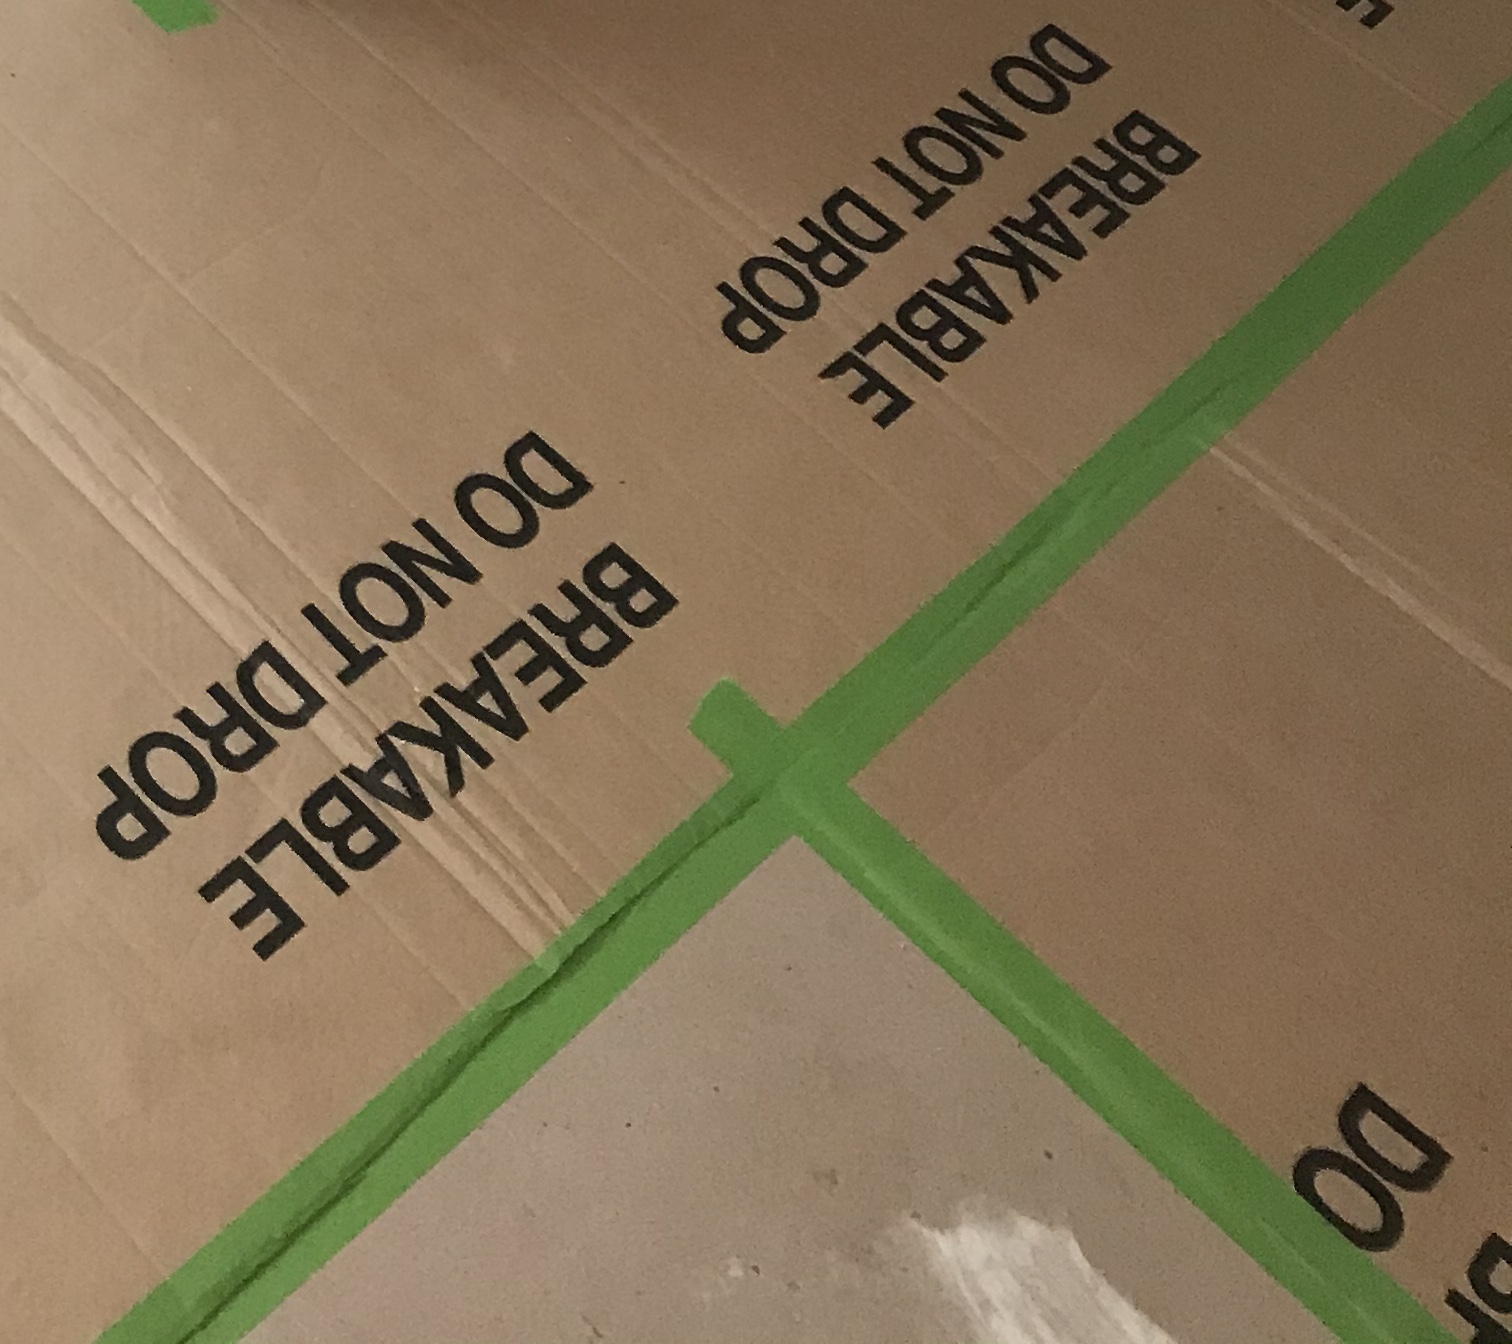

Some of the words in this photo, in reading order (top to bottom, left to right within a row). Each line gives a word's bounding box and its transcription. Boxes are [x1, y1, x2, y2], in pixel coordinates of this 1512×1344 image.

[871, 87, 1027, 220] NOT
[990, 23, 1112, 114] DO
[716, 186, 907, 355] DROP
[817, 109, 1202, 430] BREAKABLE
[453, 429, 594, 550] DO
[299, 517, 483, 687] NOT
[94, 640, 329, 861] DROP
[197, 542, 680, 962] BREAKABLE
[1291, 1081, 1454, 1253] DO
